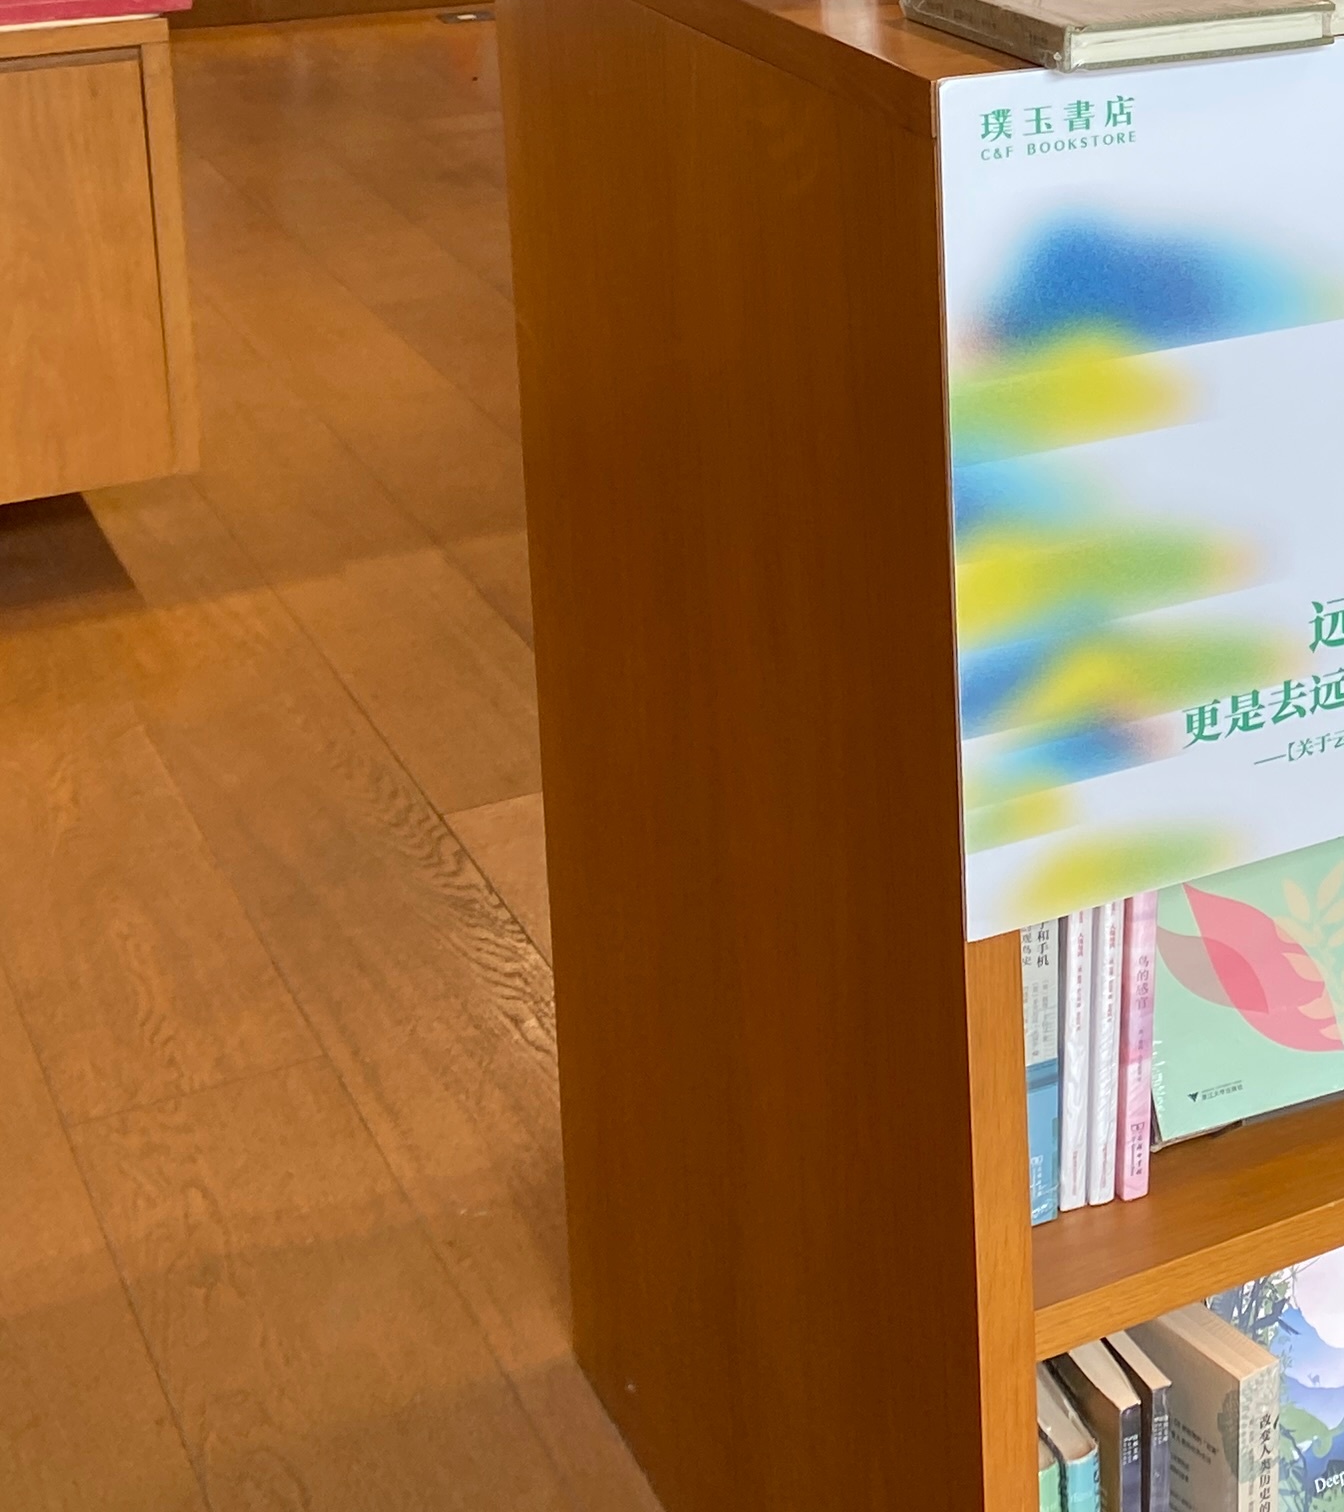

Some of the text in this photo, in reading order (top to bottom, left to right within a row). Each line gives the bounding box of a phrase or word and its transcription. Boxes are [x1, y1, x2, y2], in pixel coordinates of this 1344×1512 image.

[978, 95, 1137, 143] 璞玉書店
[979, 129, 1138, 162] C&F BOOKSTORE
